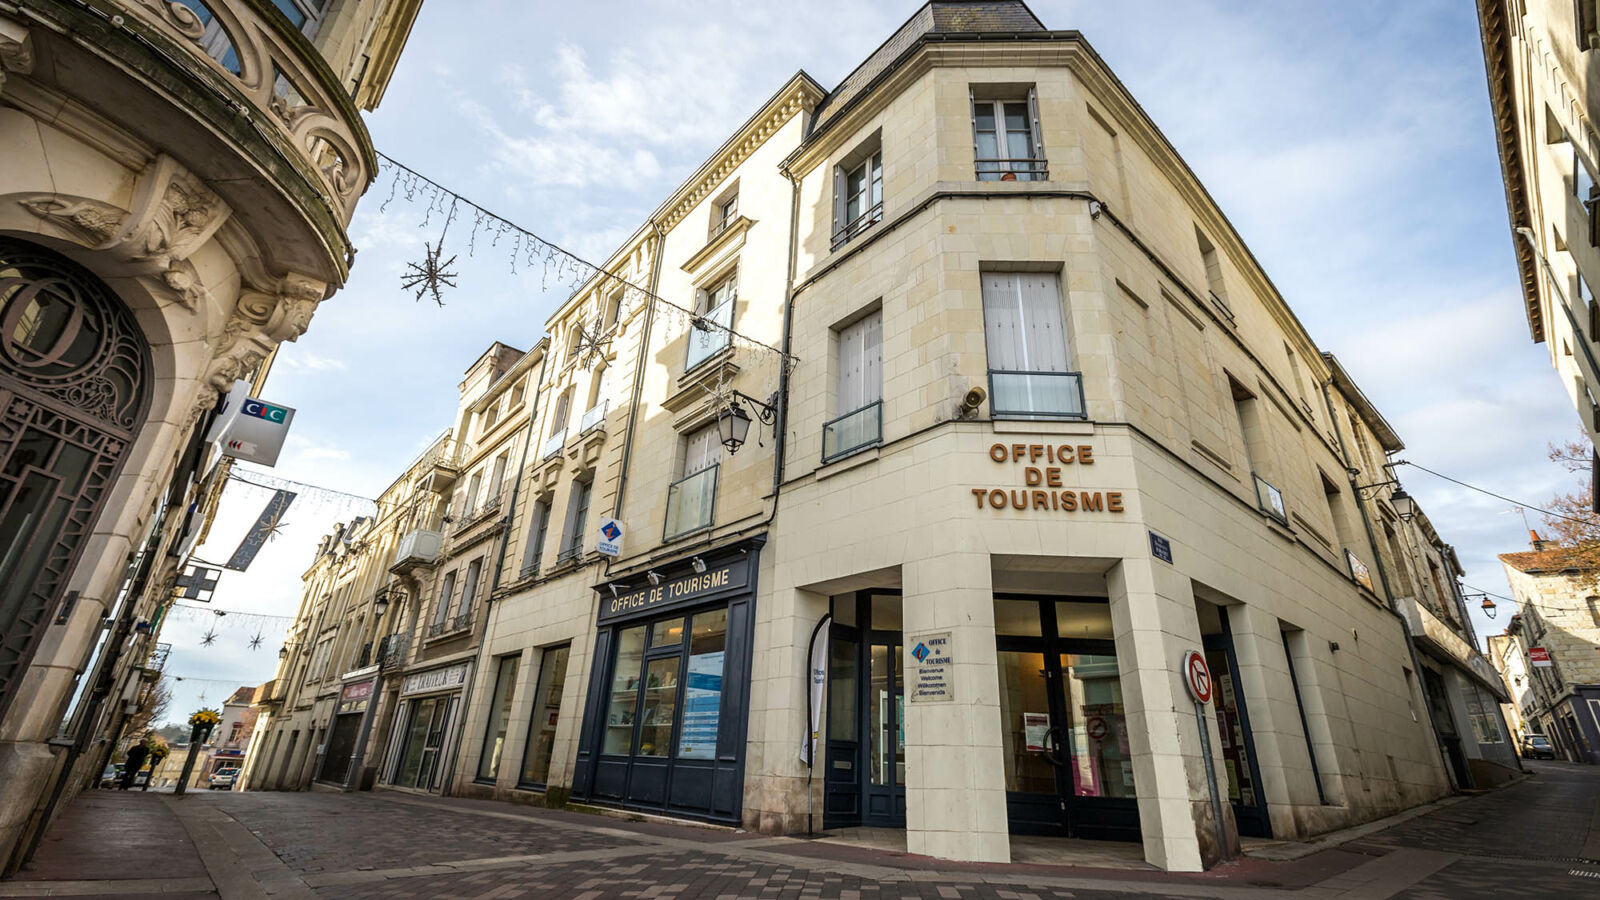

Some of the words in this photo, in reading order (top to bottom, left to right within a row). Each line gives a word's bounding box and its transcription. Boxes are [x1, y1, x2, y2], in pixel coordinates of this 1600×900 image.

[246, 403, 283, 421] CIC
[989, 443, 1094, 465] OFFICE
[1025, 466, 1063, 488] DE
[971, 488, 1124, 513] TOURISME
[611, 591, 645, 613] OFFICE
[649, 587, 664, 603] DE
[669, 569, 730, 598] TOURISME
[928, 638, 946, 646] OFFICE
[926, 657, 951, 665] TOURISME
